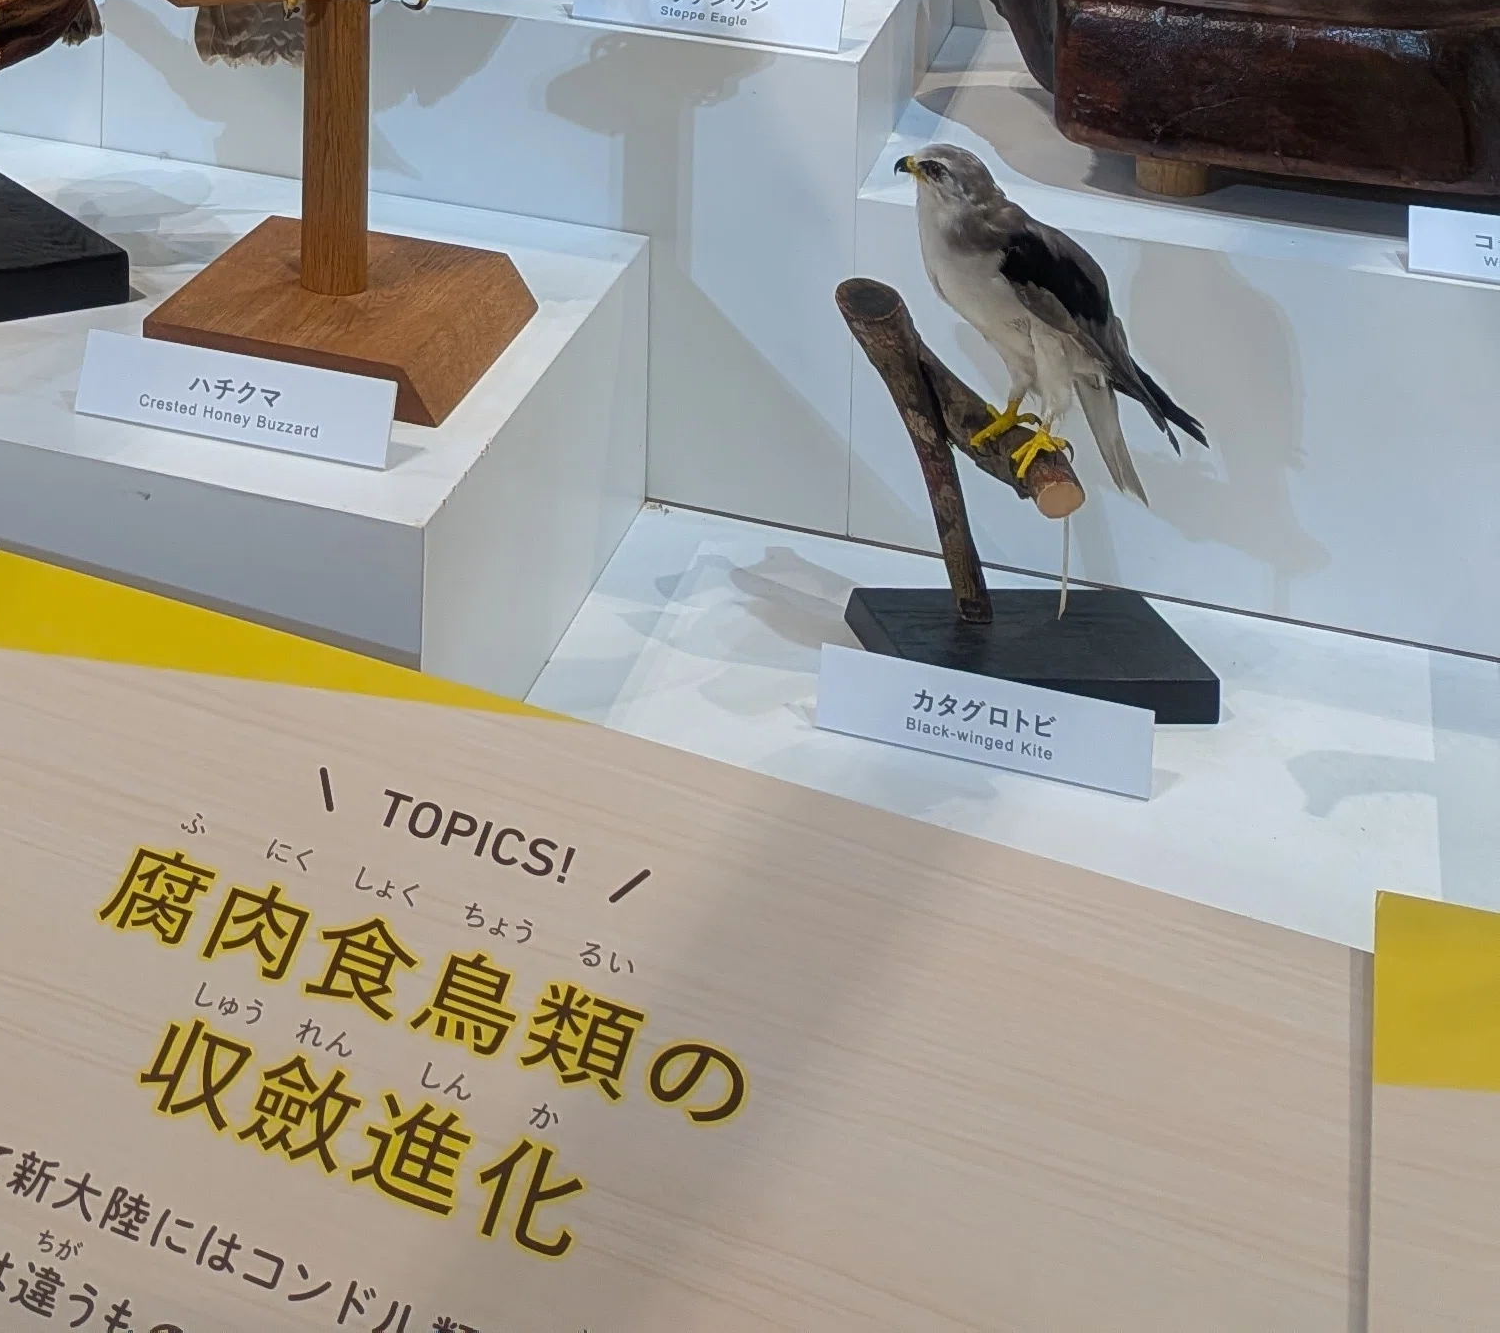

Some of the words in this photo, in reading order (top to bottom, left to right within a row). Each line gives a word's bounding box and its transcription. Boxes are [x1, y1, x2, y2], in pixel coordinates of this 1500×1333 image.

[660, 5, 706, 22] Steppe
[710, 12, 747, 27] Eagle
[139, 393, 199, 415] Crested
[203, 401, 251, 428] Honey
[256, 413, 319, 439] Buzzard
[189, 374, 281, 409] ハチクマ
[913, 688, 1057, 738] カタグロトビ
[906, 717, 1014, 753] Black-winged
[1020, 740, 1054, 761] Kite
[380, 788, 577, 885] TOPICS!
[181, 813, 206, 835] ふ
[266, 838, 314, 873] にく
[354, 866, 421, 909] しょく
[463, 903, 535, 945] ちょう
[578, 941, 636, 976] るい
[99, 845, 746, 1124] 腐肉食鳥類の
[194, 981, 266, 1026] しゅう
[296, 1018, 353, 1060] れん
[420, 1061, 472, 1103] しん
[528, 1103, 560, 1131] か
[139, 1020, 583, 1259] 収斂進化
[37, 1228, 84, 1260] ちが
